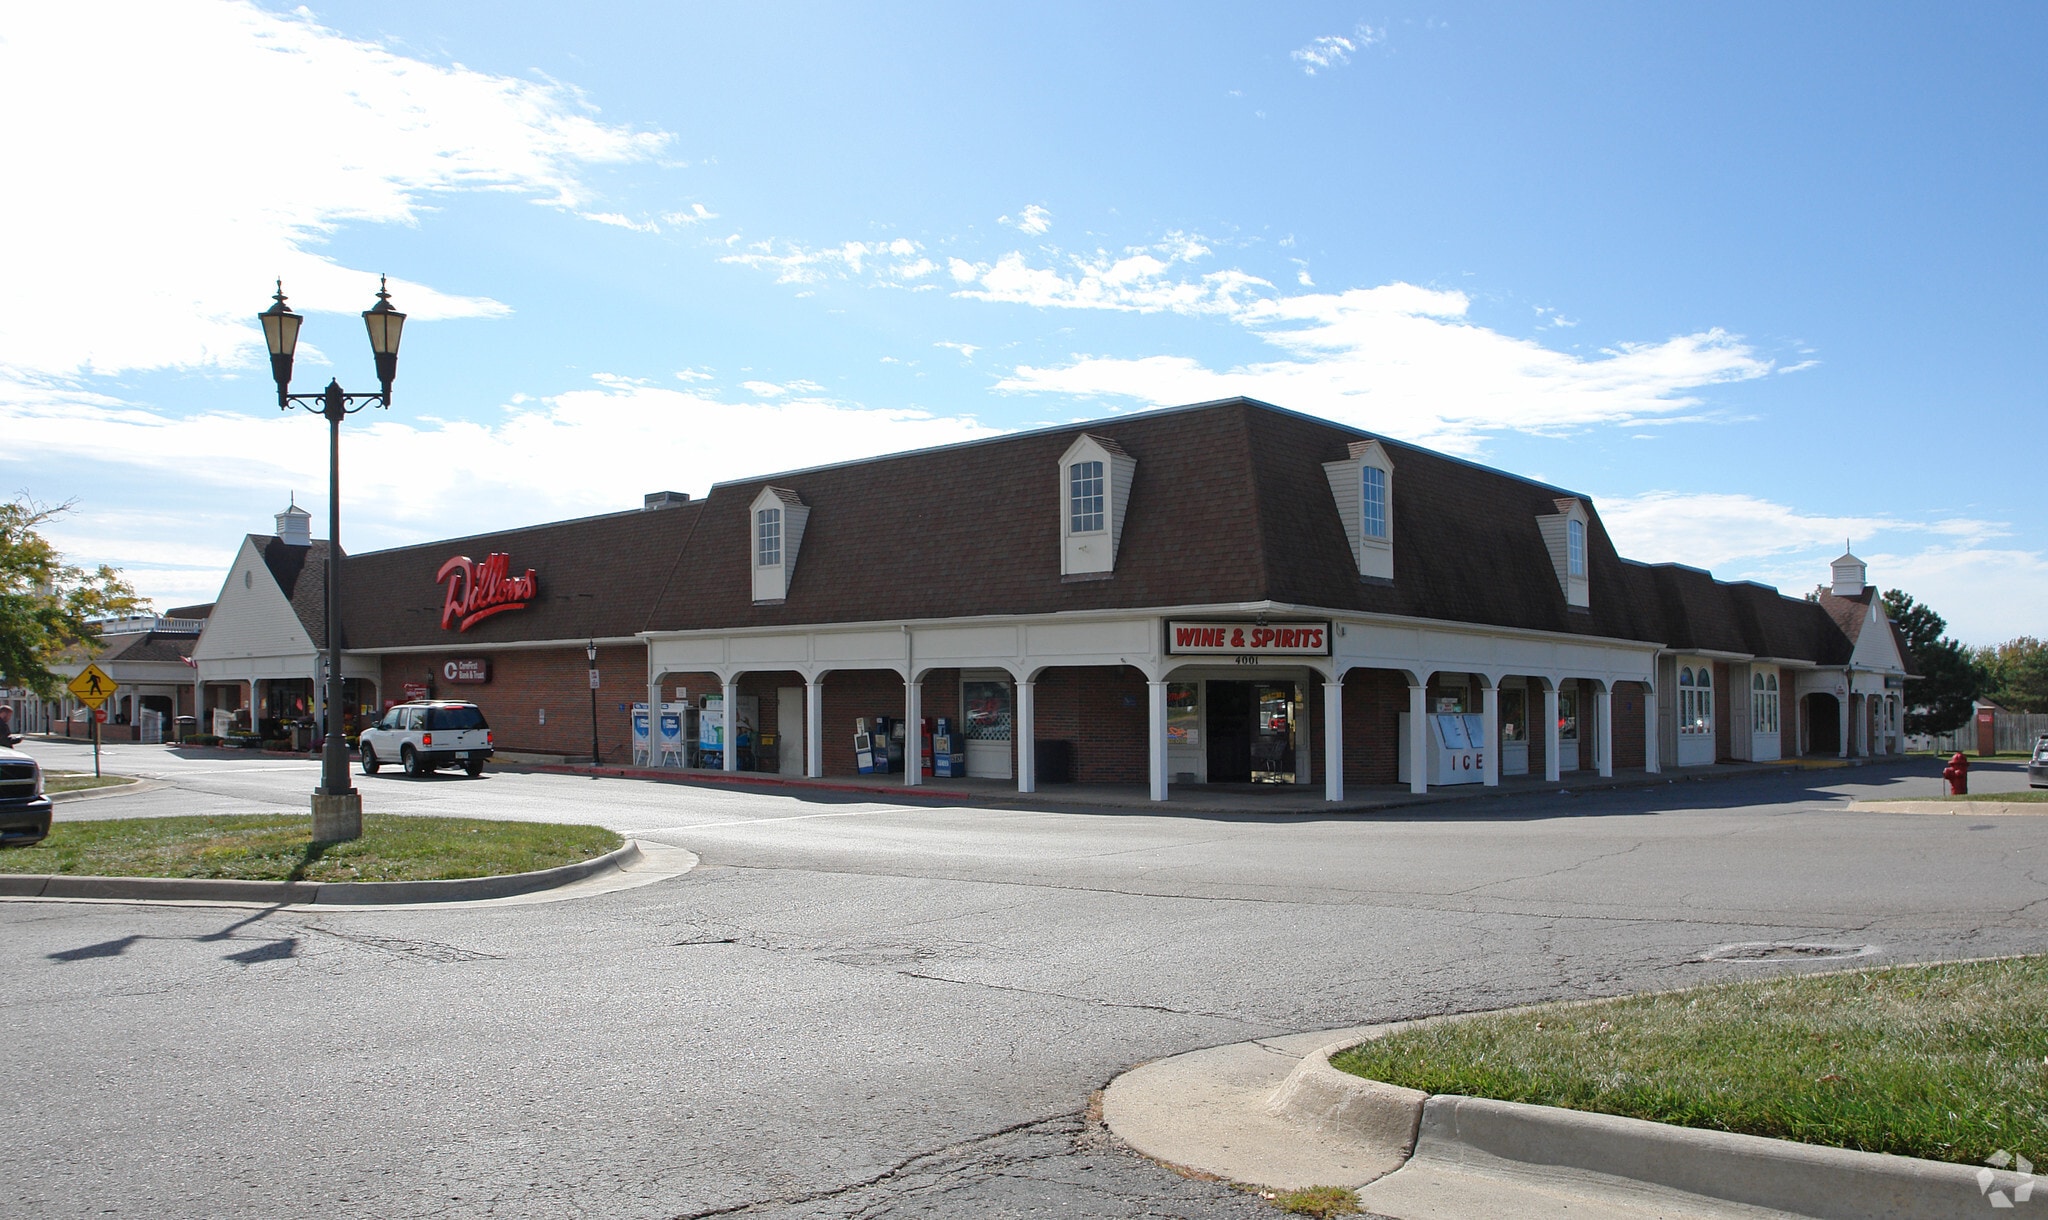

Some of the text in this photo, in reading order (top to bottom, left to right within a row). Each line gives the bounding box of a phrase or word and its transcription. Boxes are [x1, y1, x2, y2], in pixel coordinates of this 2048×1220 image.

[436, 552, 537, 630] Dillons
[1176, 628, 1323, 648] WINE & SPIRITS
[1235, 656, 1259, 665] 4001
[1452, 753, 1483, 771] ICE
